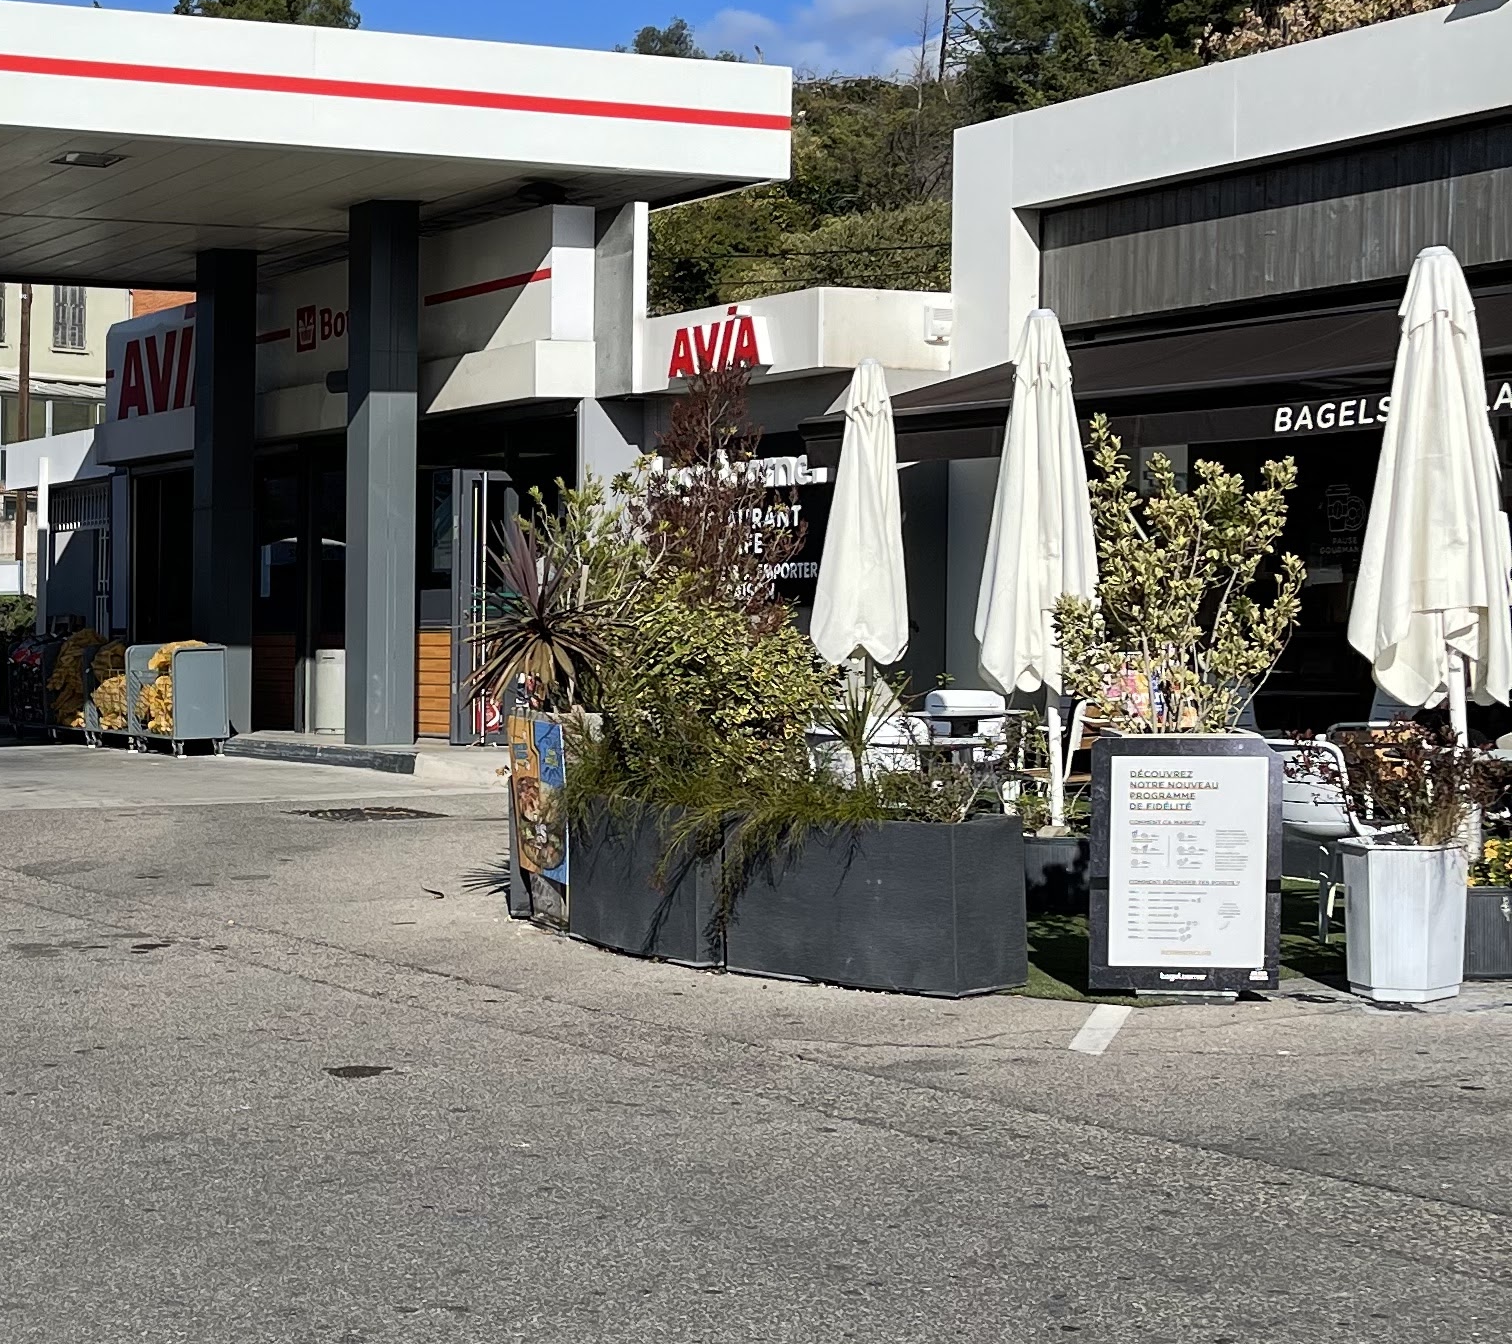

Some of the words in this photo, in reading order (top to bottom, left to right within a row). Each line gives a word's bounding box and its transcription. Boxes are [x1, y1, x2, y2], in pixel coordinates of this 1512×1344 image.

[117, 303, 196, 420] AVI
[1129, 781, 1165, 790] NOTRE
[1168, 781, 1220, 790] NOUVEAU
[1129, 792, 1197, 801] PROGRAMME
[1129, 803, 1143, 811] DE
